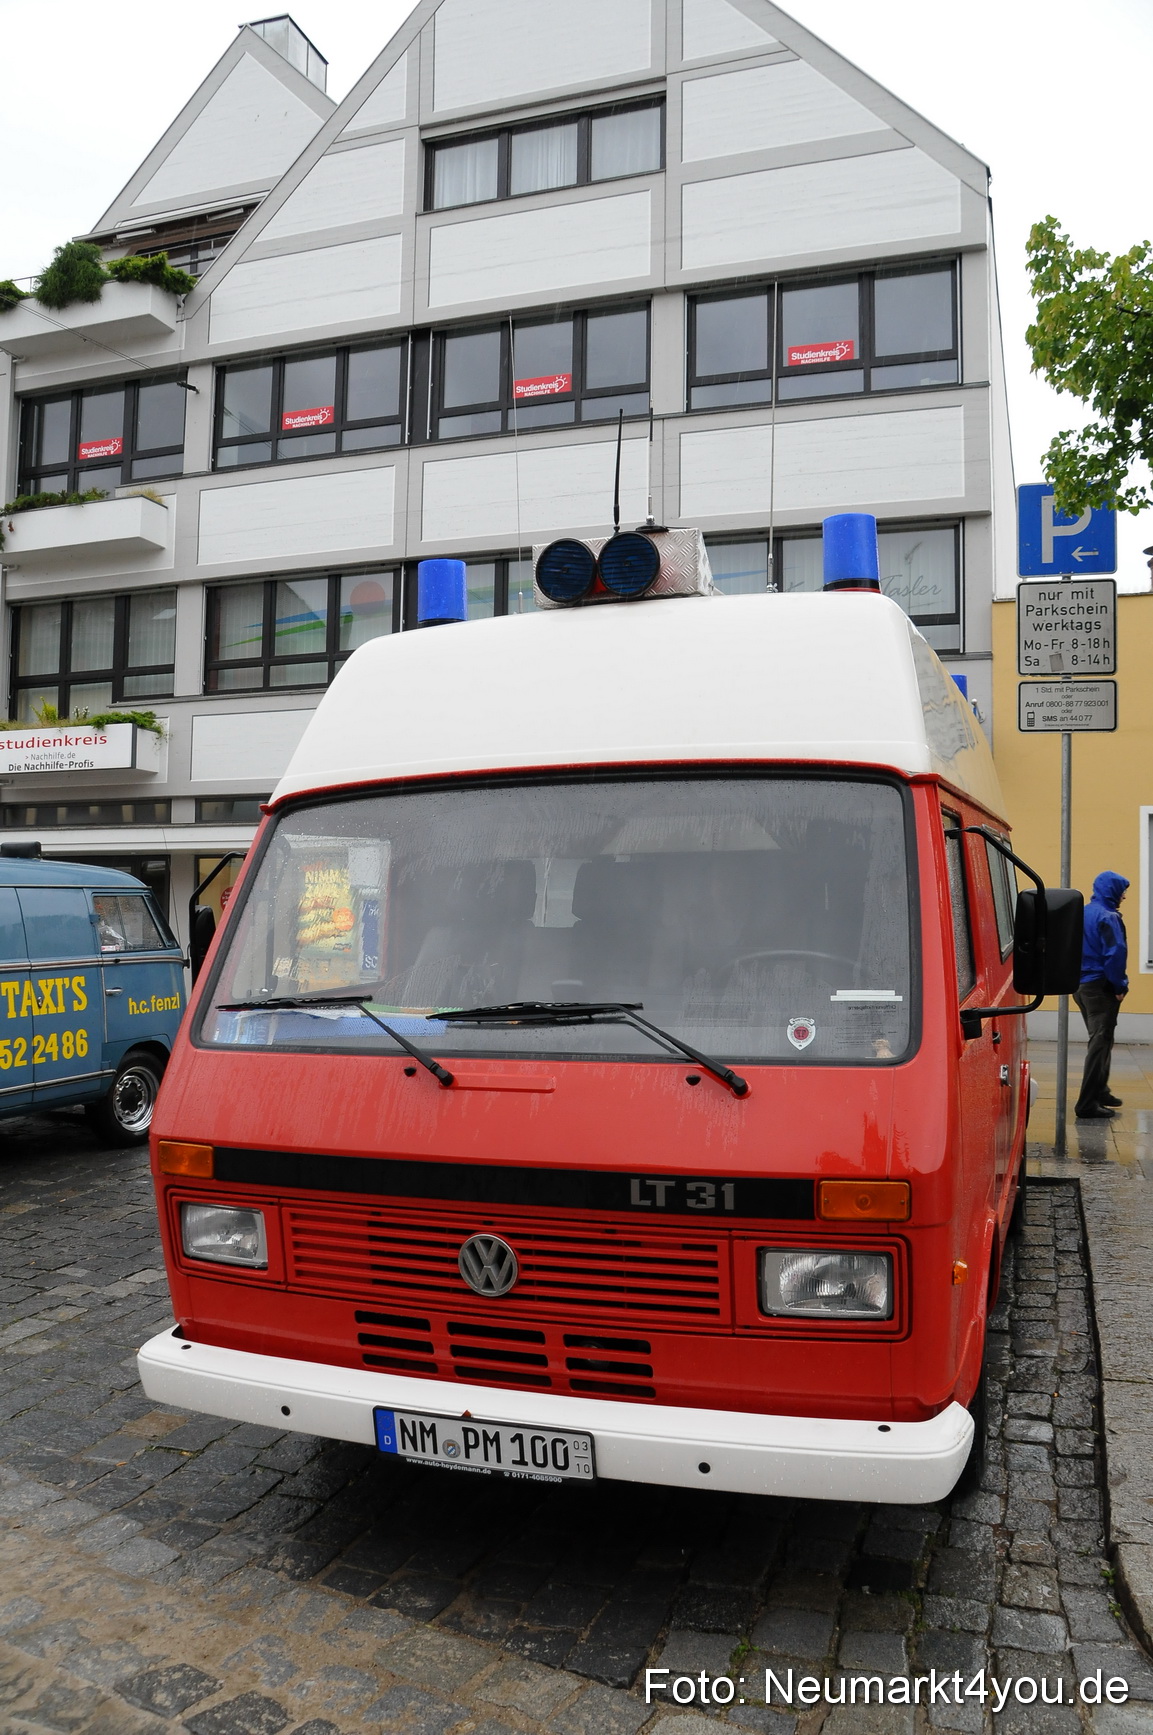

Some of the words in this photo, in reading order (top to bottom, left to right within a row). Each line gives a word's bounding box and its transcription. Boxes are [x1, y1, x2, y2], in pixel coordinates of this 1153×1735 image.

[792, 348, 840, 360] Studienkreis
[516, 382, 558, 393] Studienkreis
[285, 414, 322, 424] Studienkreis
[82, 445, 114, 455] Studienkreis
[1042, 496, 1092, 563] P
[1038, 590, 1063, 601] nur
[1071, 587, 1094, 599] mit
[1026, 603, 1108, 617] Parkschein
[1032, 620, 1102, 633] werktags
[1024, 656, 1040, 666] Sa
[0, 734, 108, 750] studienkreis
[30, 752, 76, 760] Nachhilfe.de
[8, 763, 21, 772] Die
[24, 760, 94, 771] Nachhilfe-Profis
[0, 976, 88, 1019] TAXI'S
[630, 1178, 676, 1207] LT
[686, 1182, 735, 1210] 31
[459, 1235, 518, 1296] VW
[384, 1435, 392, 1445] D
[400, 1418, 438, 1455] NM
[462, 1426, 501, 1464] PM
[510, 1433, 570, 1471] 100
[573, 1440, 588, 1451] 03
[406, 1456, 492, 1475] www.auto-heydemann.de
[576, 1462, 590, 1474] 10
